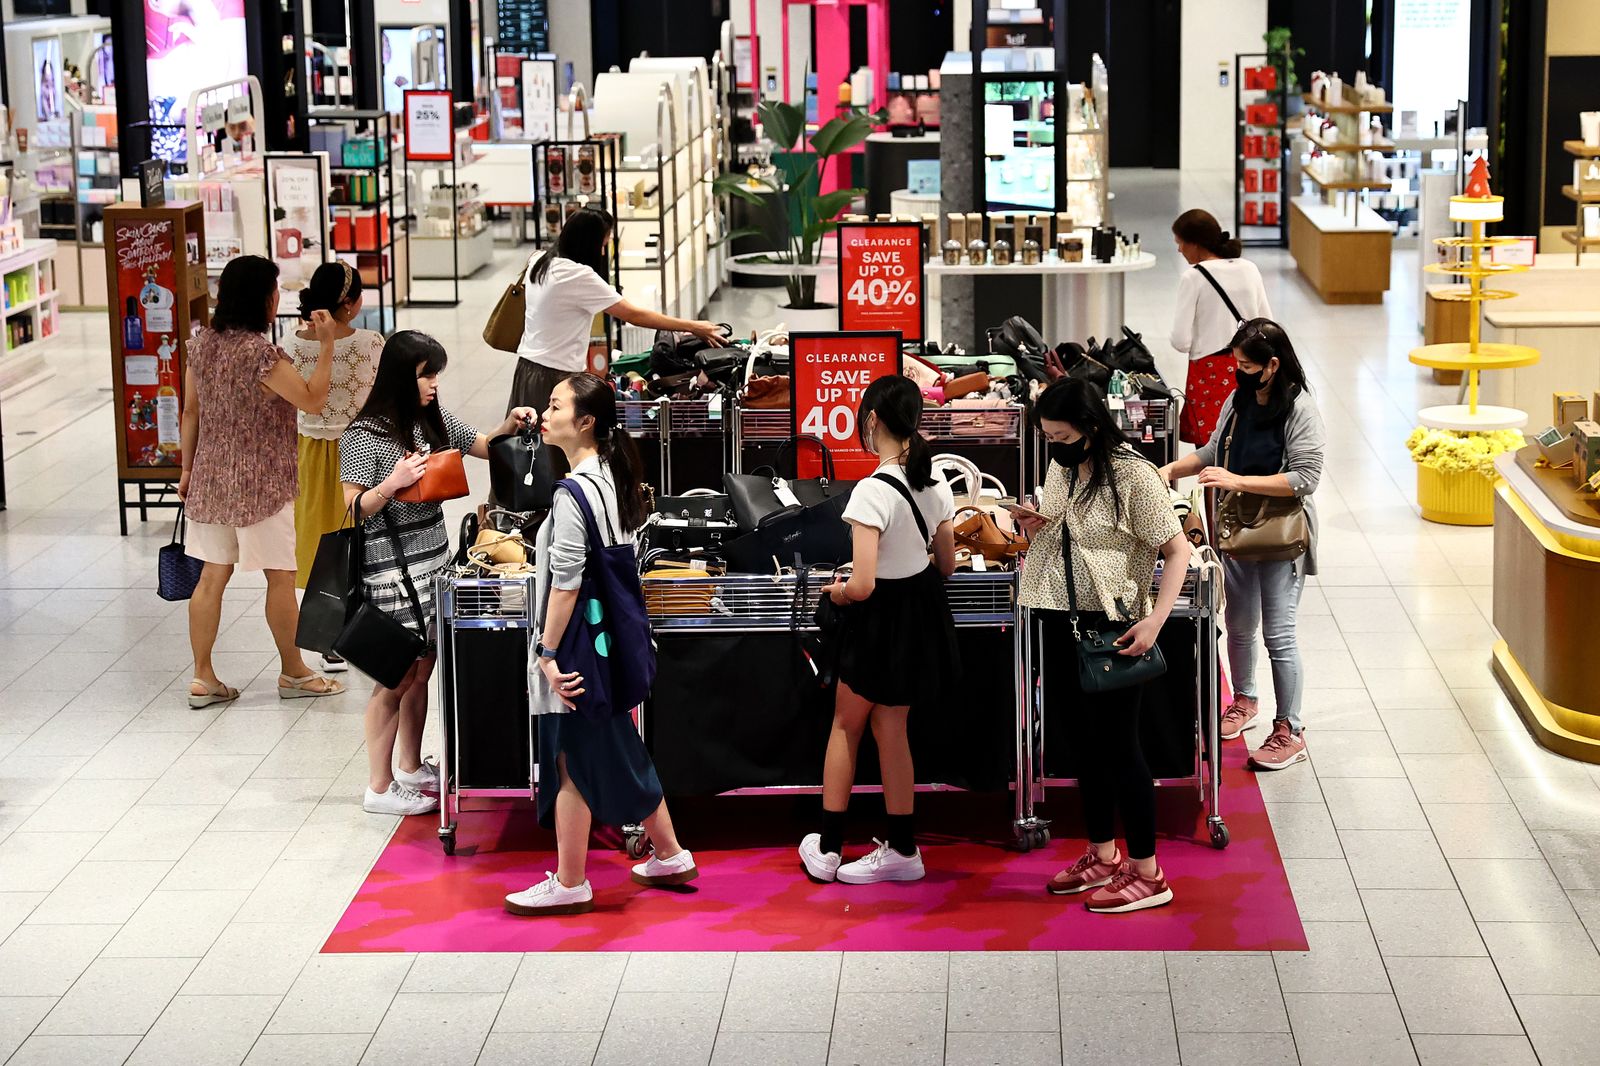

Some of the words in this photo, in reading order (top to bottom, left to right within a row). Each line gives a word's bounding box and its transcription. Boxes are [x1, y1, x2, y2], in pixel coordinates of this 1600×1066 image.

[850, 238, 912, 247] CLEARANCE
[862, 251, 901, 264] SAVE
[858, 265, 880, 278] UP
[882, 265, 905, 277] TO
[847, 278, 917, 306] 40%
[805, 353, 886, 363] CLEARANCE
[820, 370, 871, 385] SAVE
[816, 388, 843, 403] UP
[801, 405, 857, 441] 40
